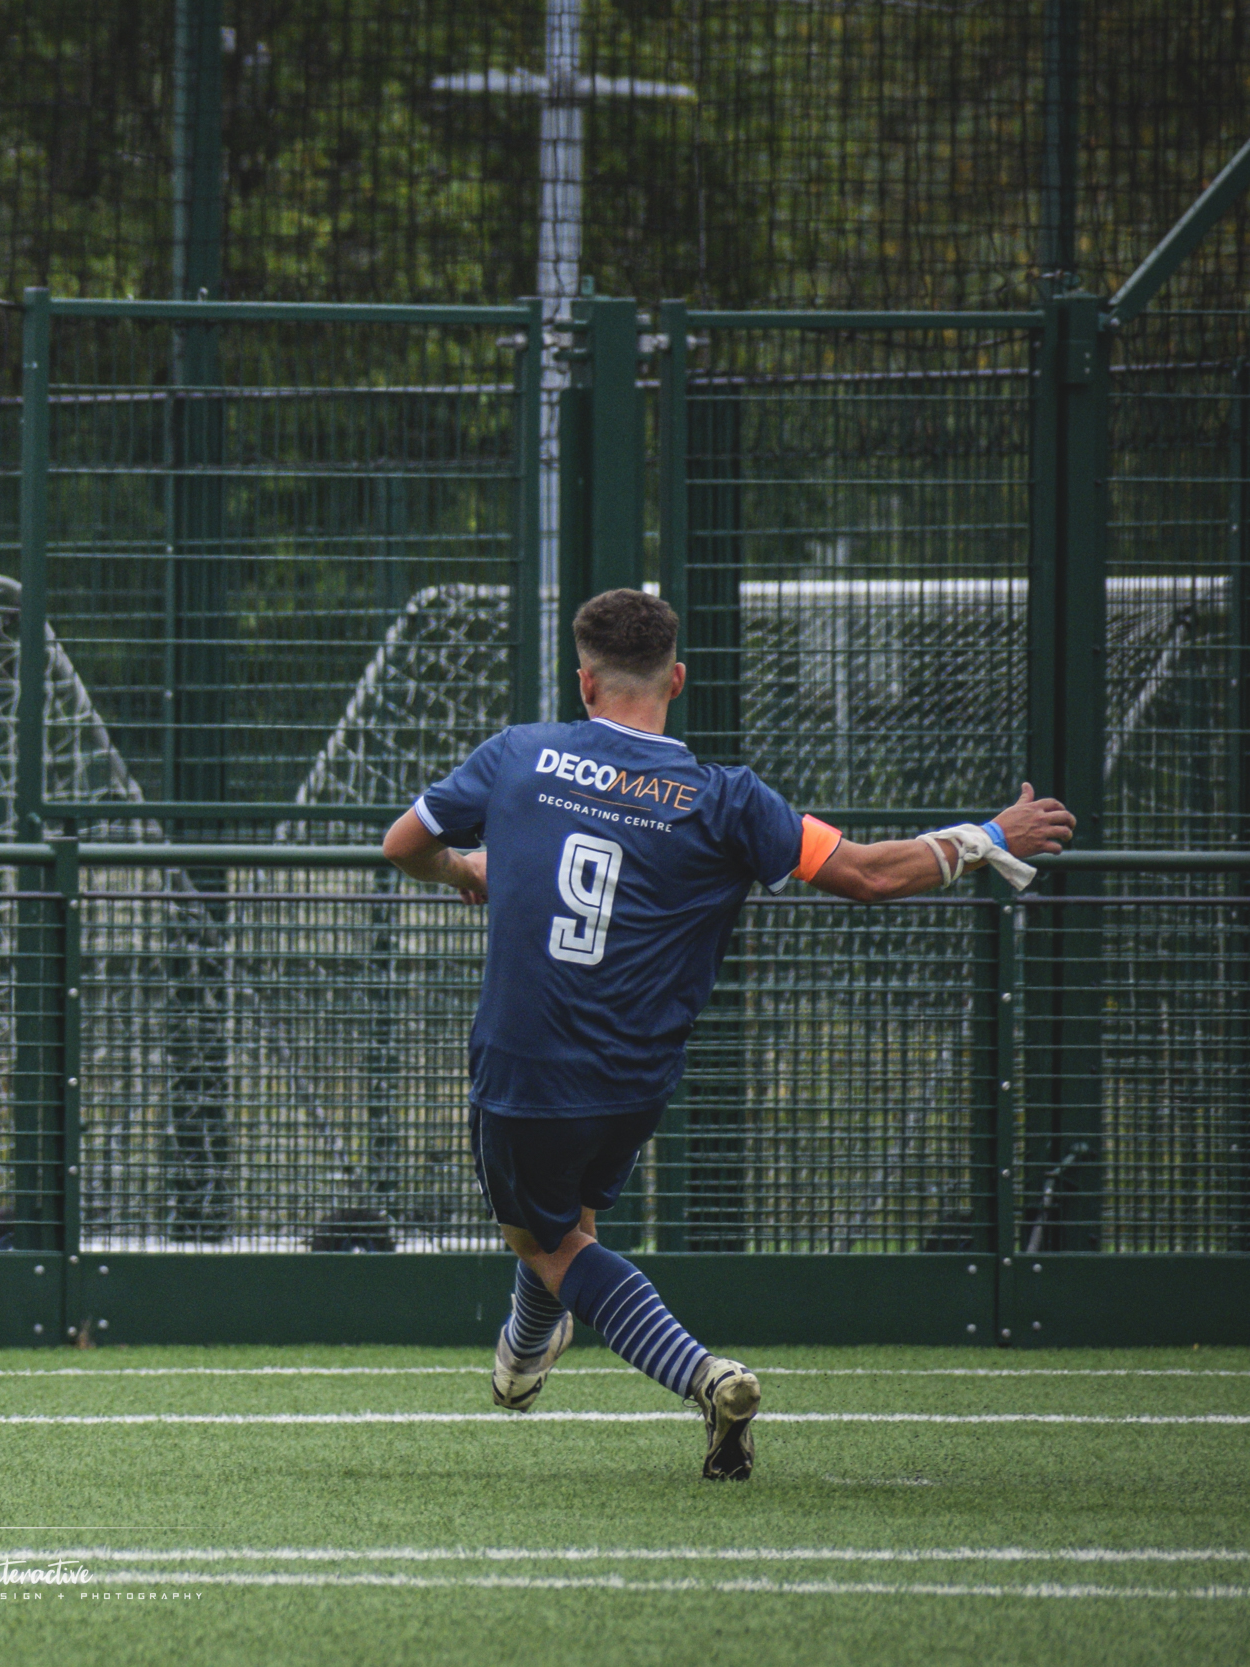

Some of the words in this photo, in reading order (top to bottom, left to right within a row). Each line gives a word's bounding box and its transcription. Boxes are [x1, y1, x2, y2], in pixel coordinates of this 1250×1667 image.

[535, 748, 698, 811] DECOMATE
[538, 793, 620, 822] DECORATING
[624, 815, 673, 833] CENTRE
[548, 832, 624, 966] 9
